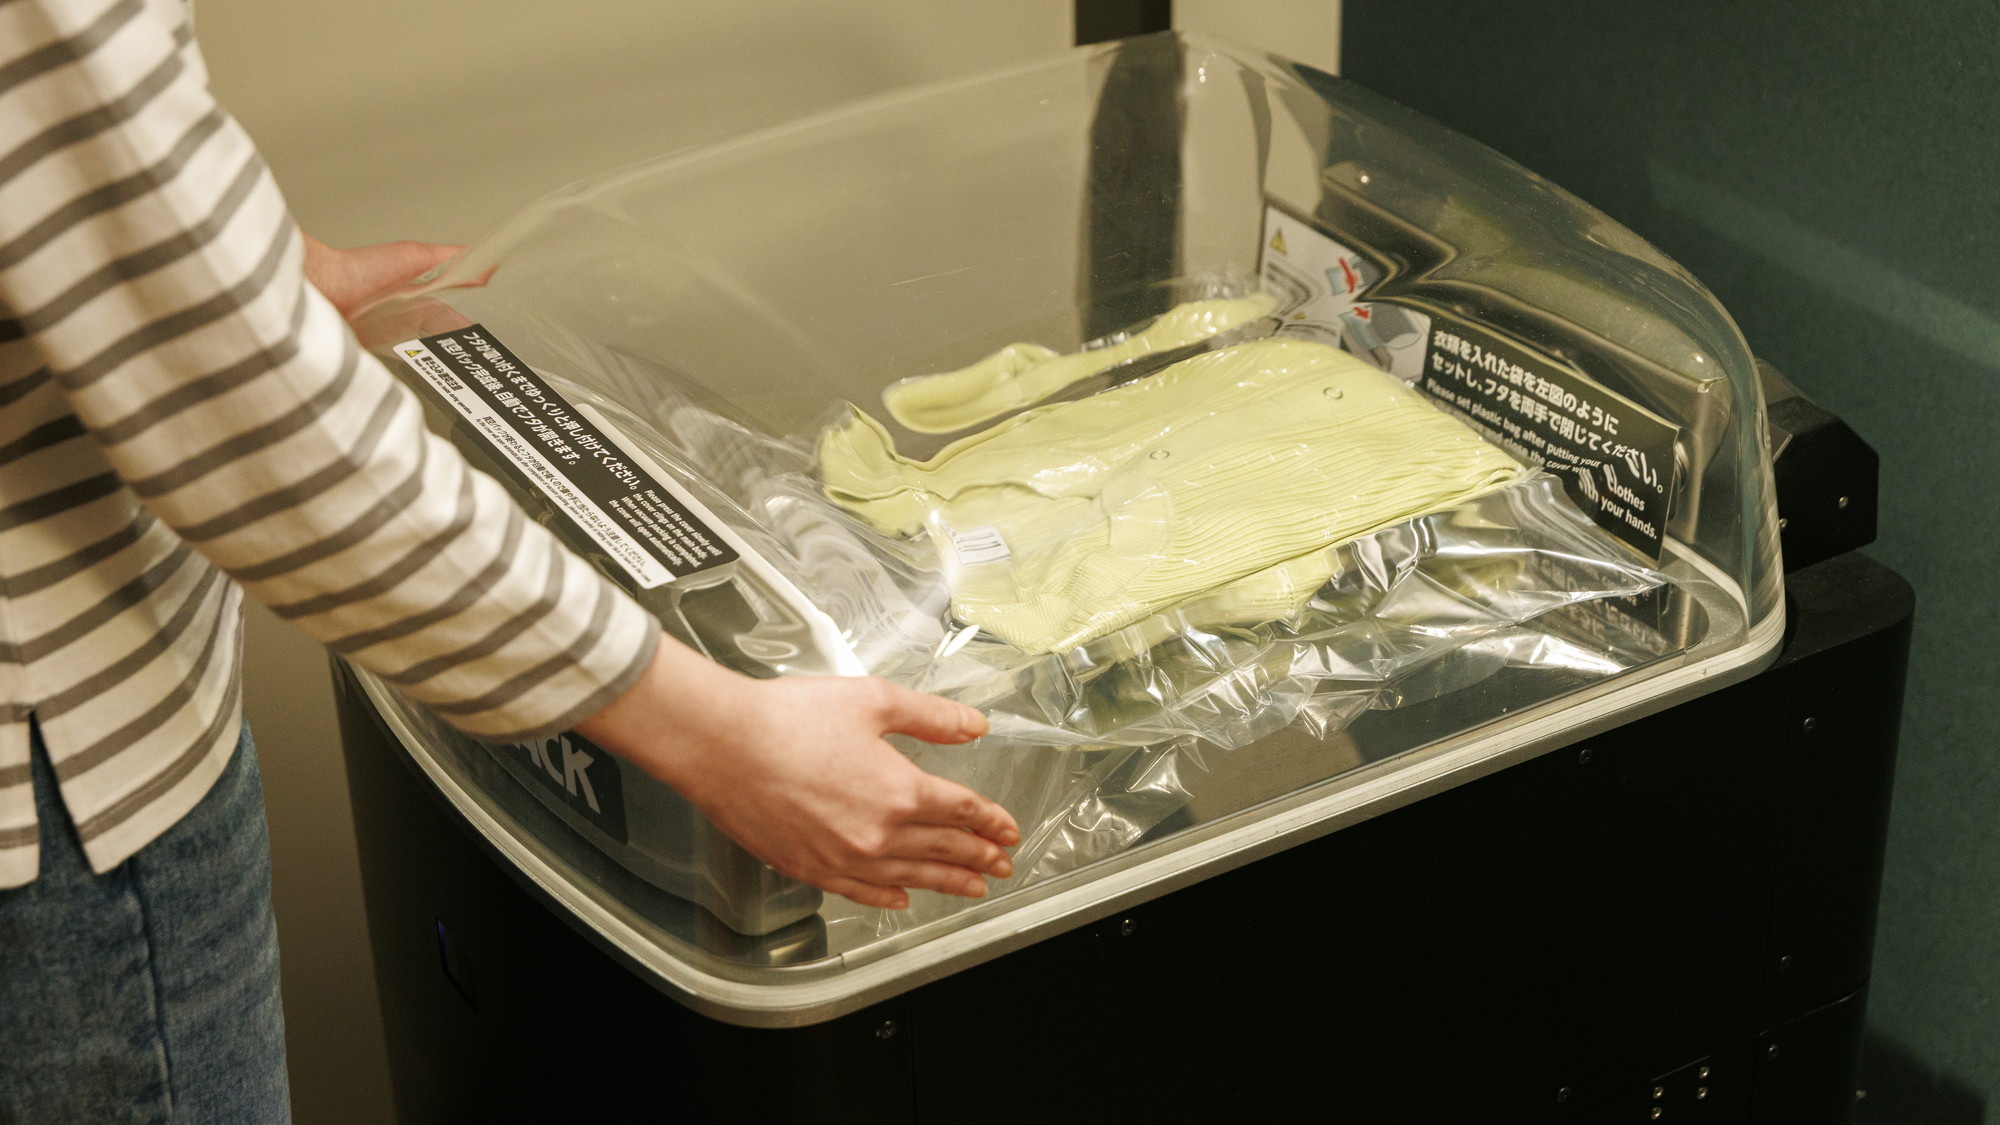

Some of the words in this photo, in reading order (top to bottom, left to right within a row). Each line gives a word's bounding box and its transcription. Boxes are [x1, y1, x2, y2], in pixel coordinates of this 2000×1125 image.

[437, 338, 581, 465] 真空パック完成後、自動でフタが開きます。
[463, 332, 640, 490] フタが吸い付くまでゆっくりと押し付けてください。
[1426, 377, 1456, 402] Please
[1456, 395, 1471, 410] set
[1471, 402, 1502, 426] plastic
[1503, 417, 1521, 439] bag
[1522, 430, 1546, 448] after
[1546, 443, 1580, 464] putting
[1579, 457, 1602, 468] your
[1433, 330, 1619, 435] 衣類を入れた袋を左図のように
[609, 500, 620, 508] the
[617, 507, 632, 519] cover
[629, 518, 643, 527] will
[637, 526, 652, 537] open
[621, 496, 637, 509] When
[634, 509, 654, 524] vacuum
[649, 524, 671, 541] packing
[668, 538, 676, 546] is
[633, 493, 644, 501] the
[641, 501, 656, 512] cover
[672, 529, 684, 537] the
[680, 536, 695, 547] main
[645, 490, 662, 503] Please
[657, 503, 674, 514] press
[671, 513, 682, 521] the
[679, 521, 695, 532] cover
[691, 532, 710, 546] slowly
[707, 545, 722, 556] until
[1530, 450, 1546, 466] the
[1546, 460, 1571, 471] cover
[1600, 495, 1625, 519] your
[1625, 509, 1657, 540] hands.
